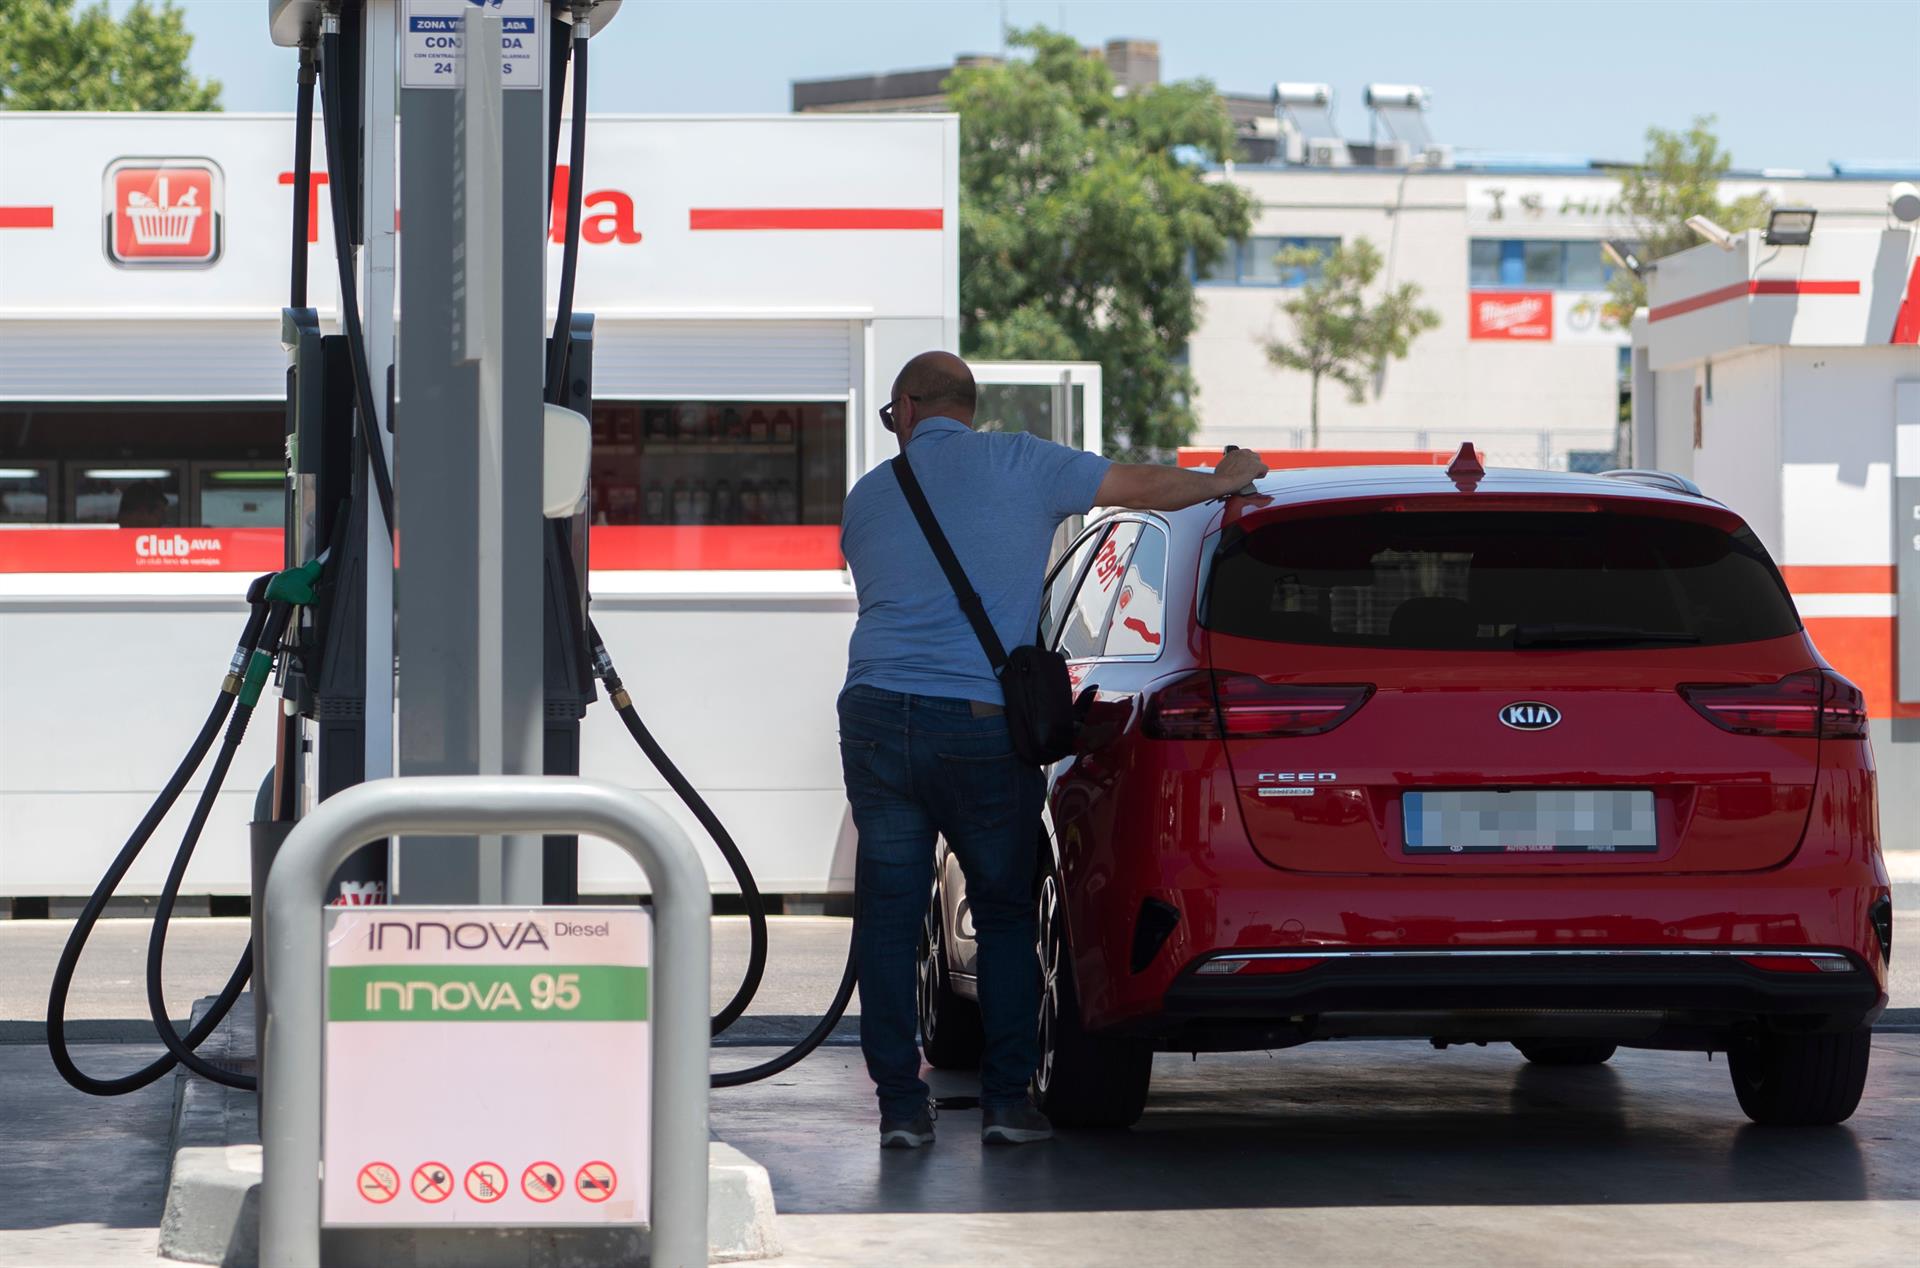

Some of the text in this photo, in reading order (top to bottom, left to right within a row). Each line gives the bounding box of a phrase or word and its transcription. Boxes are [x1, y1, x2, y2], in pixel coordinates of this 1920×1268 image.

[416, 20, 446, 29] ZONA
[433, 62, 453, 74] 24
[135, 534, 222, 557] Club AVIA
[1509, 705, 1552, 724] KIA
[1258, 772, 1337, 783] CEED
[554, 921, 610, 938] Diesel
[529, 973, 582, 1011] 95
